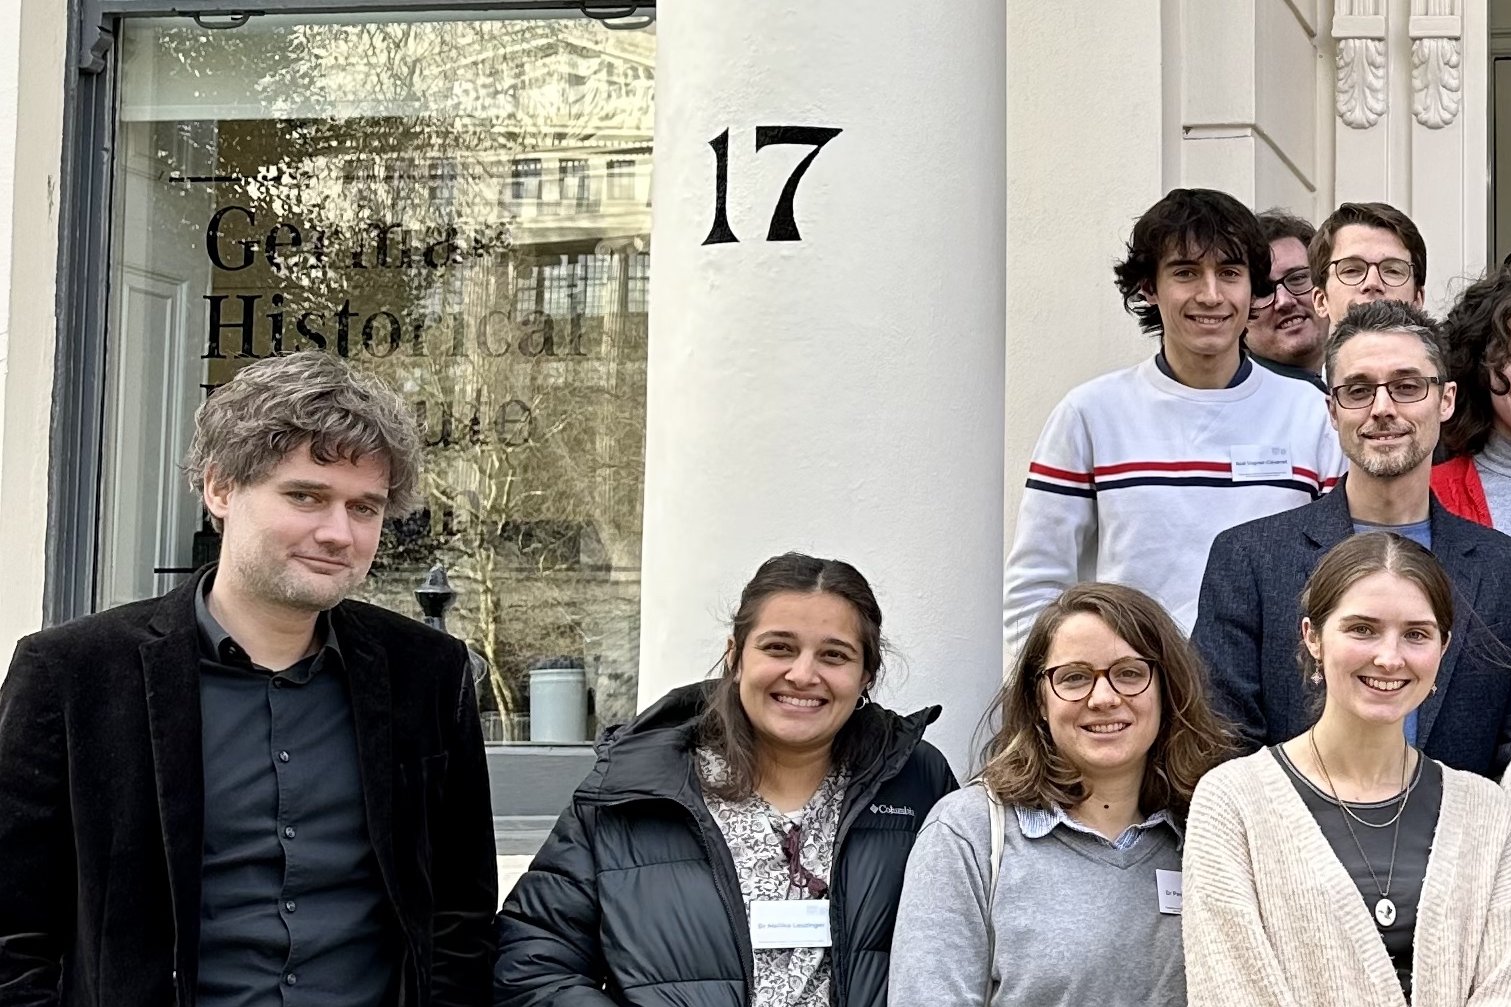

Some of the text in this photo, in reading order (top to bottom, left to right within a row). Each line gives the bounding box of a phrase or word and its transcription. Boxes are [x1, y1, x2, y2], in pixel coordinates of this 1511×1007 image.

[701, 126, 843, 246] 17
[206, 205, 512, 272] Germa
[200, 293, 588, 359] Historical
[878, 804, 915, 817] Columbia
